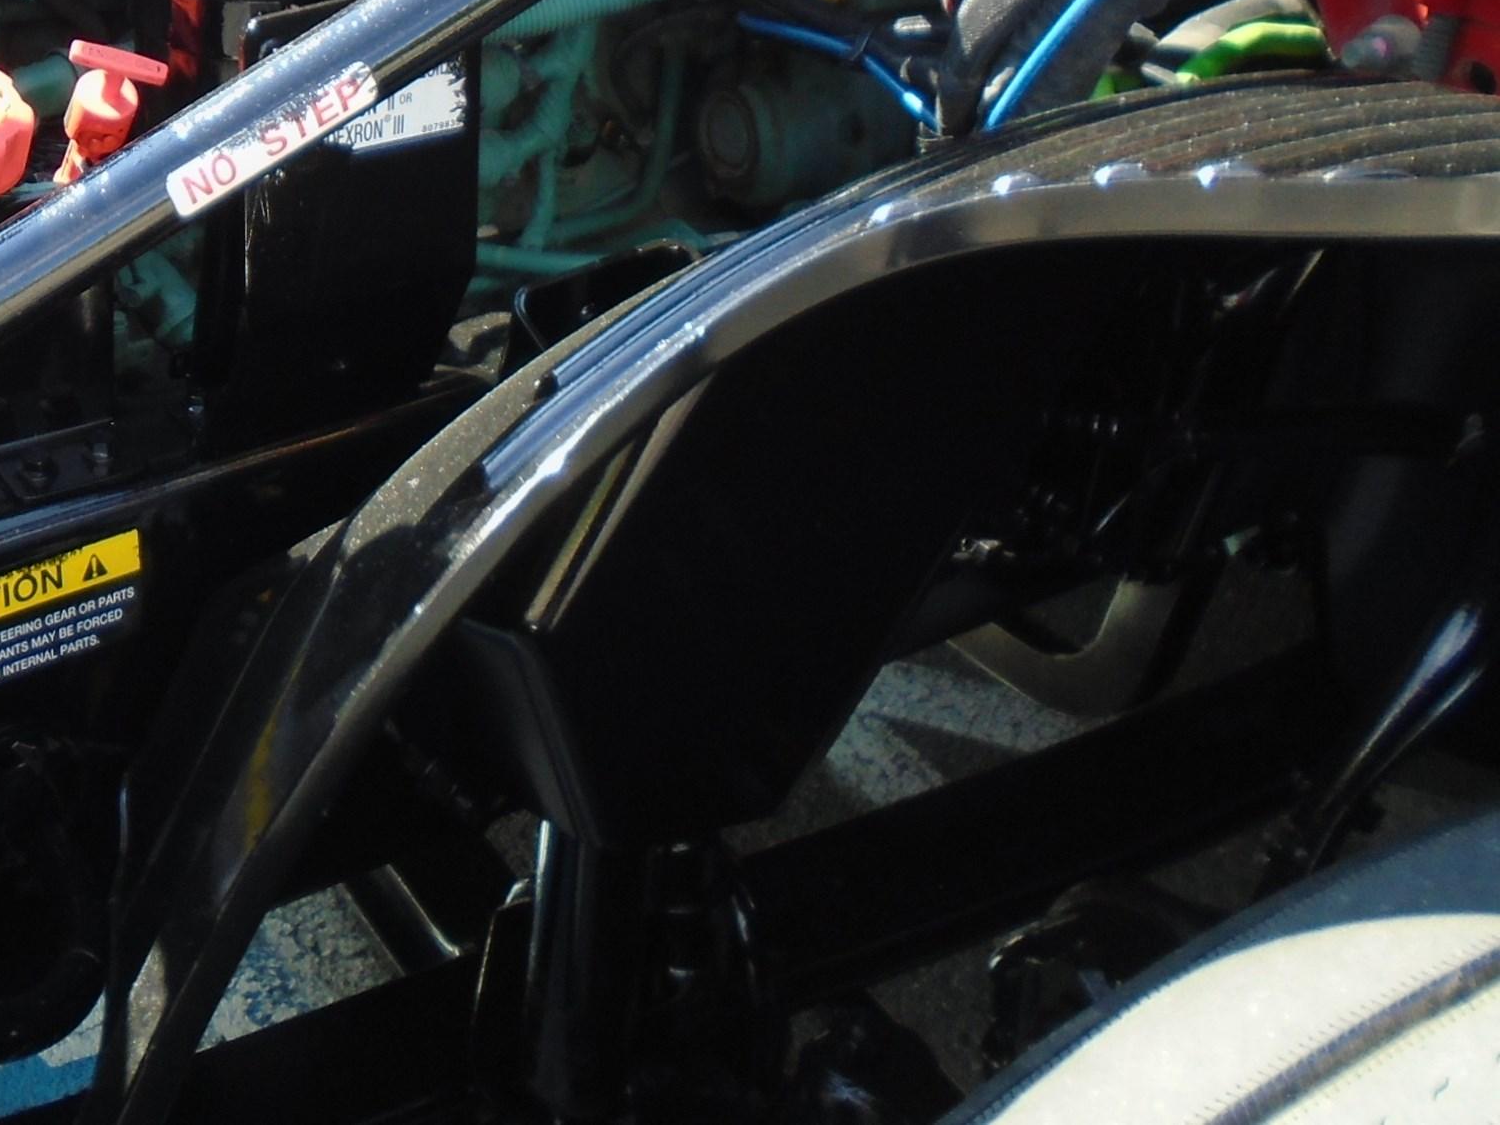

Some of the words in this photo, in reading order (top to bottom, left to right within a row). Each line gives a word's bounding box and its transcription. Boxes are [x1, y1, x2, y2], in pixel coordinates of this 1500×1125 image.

[182, 154, 237, 206] NO
[260, 73, 362, 157] STEP
[45, 606, 77, 626] GEAR
[78, 600, 96, 616] OR
[98, 586, 135, 608] PARTS
[31, 631, 56, 650] MAY
[58, 624, 74, 639] BE
[76, 608, 123, 634] FORCED
[2, 650, 58, 677] INTERNAL
[60, 634, 100, 657] PARTS.
